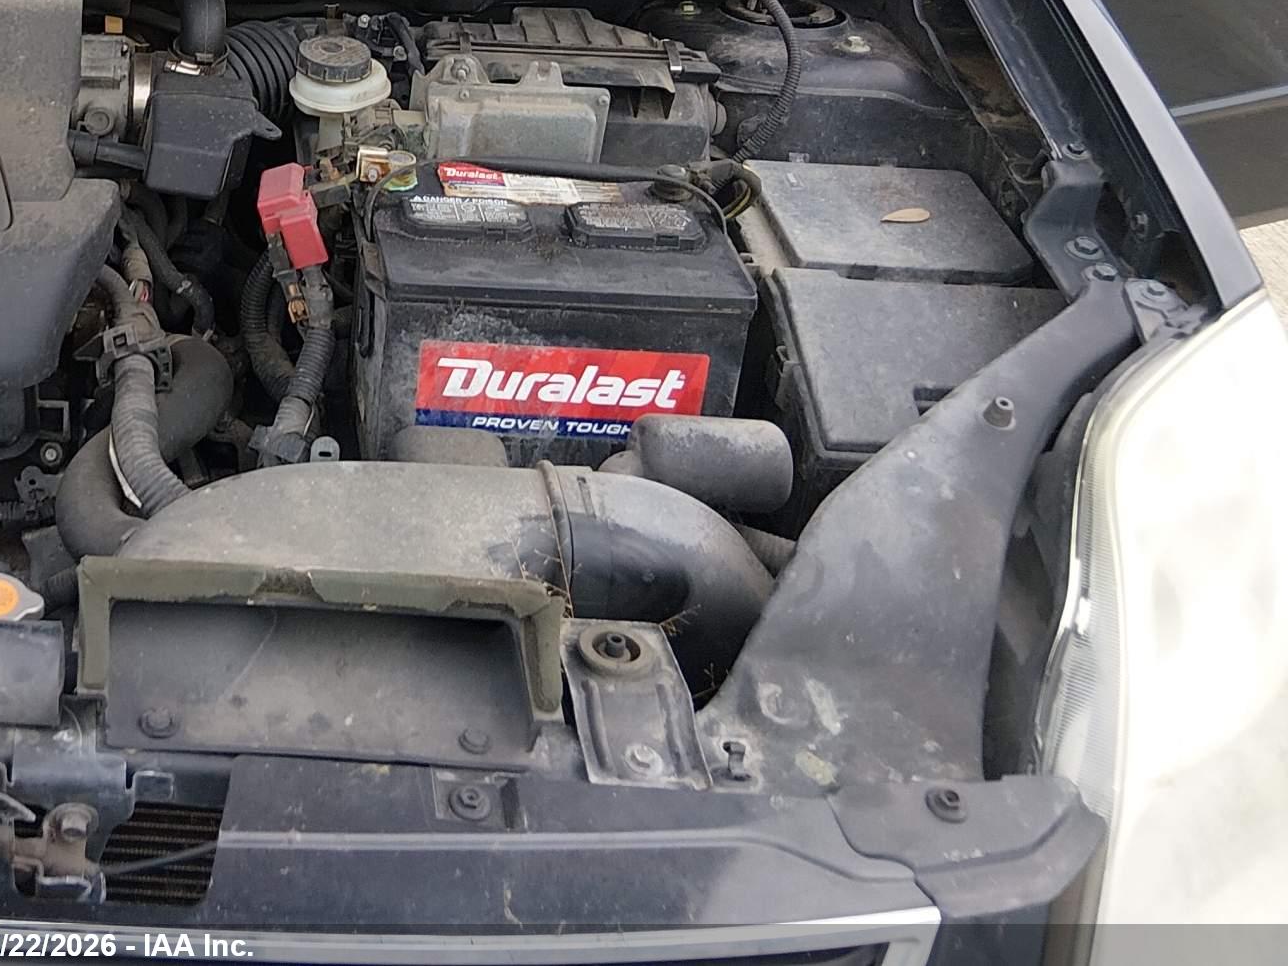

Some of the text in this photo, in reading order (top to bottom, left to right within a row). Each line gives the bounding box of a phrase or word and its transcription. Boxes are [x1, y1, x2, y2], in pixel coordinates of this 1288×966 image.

[444, 167, 499, 180] Duralast
[422, 195, 463, 205] DANGER
[437, 357, 685, 409] Duralast
[472, 416, 559, 432] PROVEN
